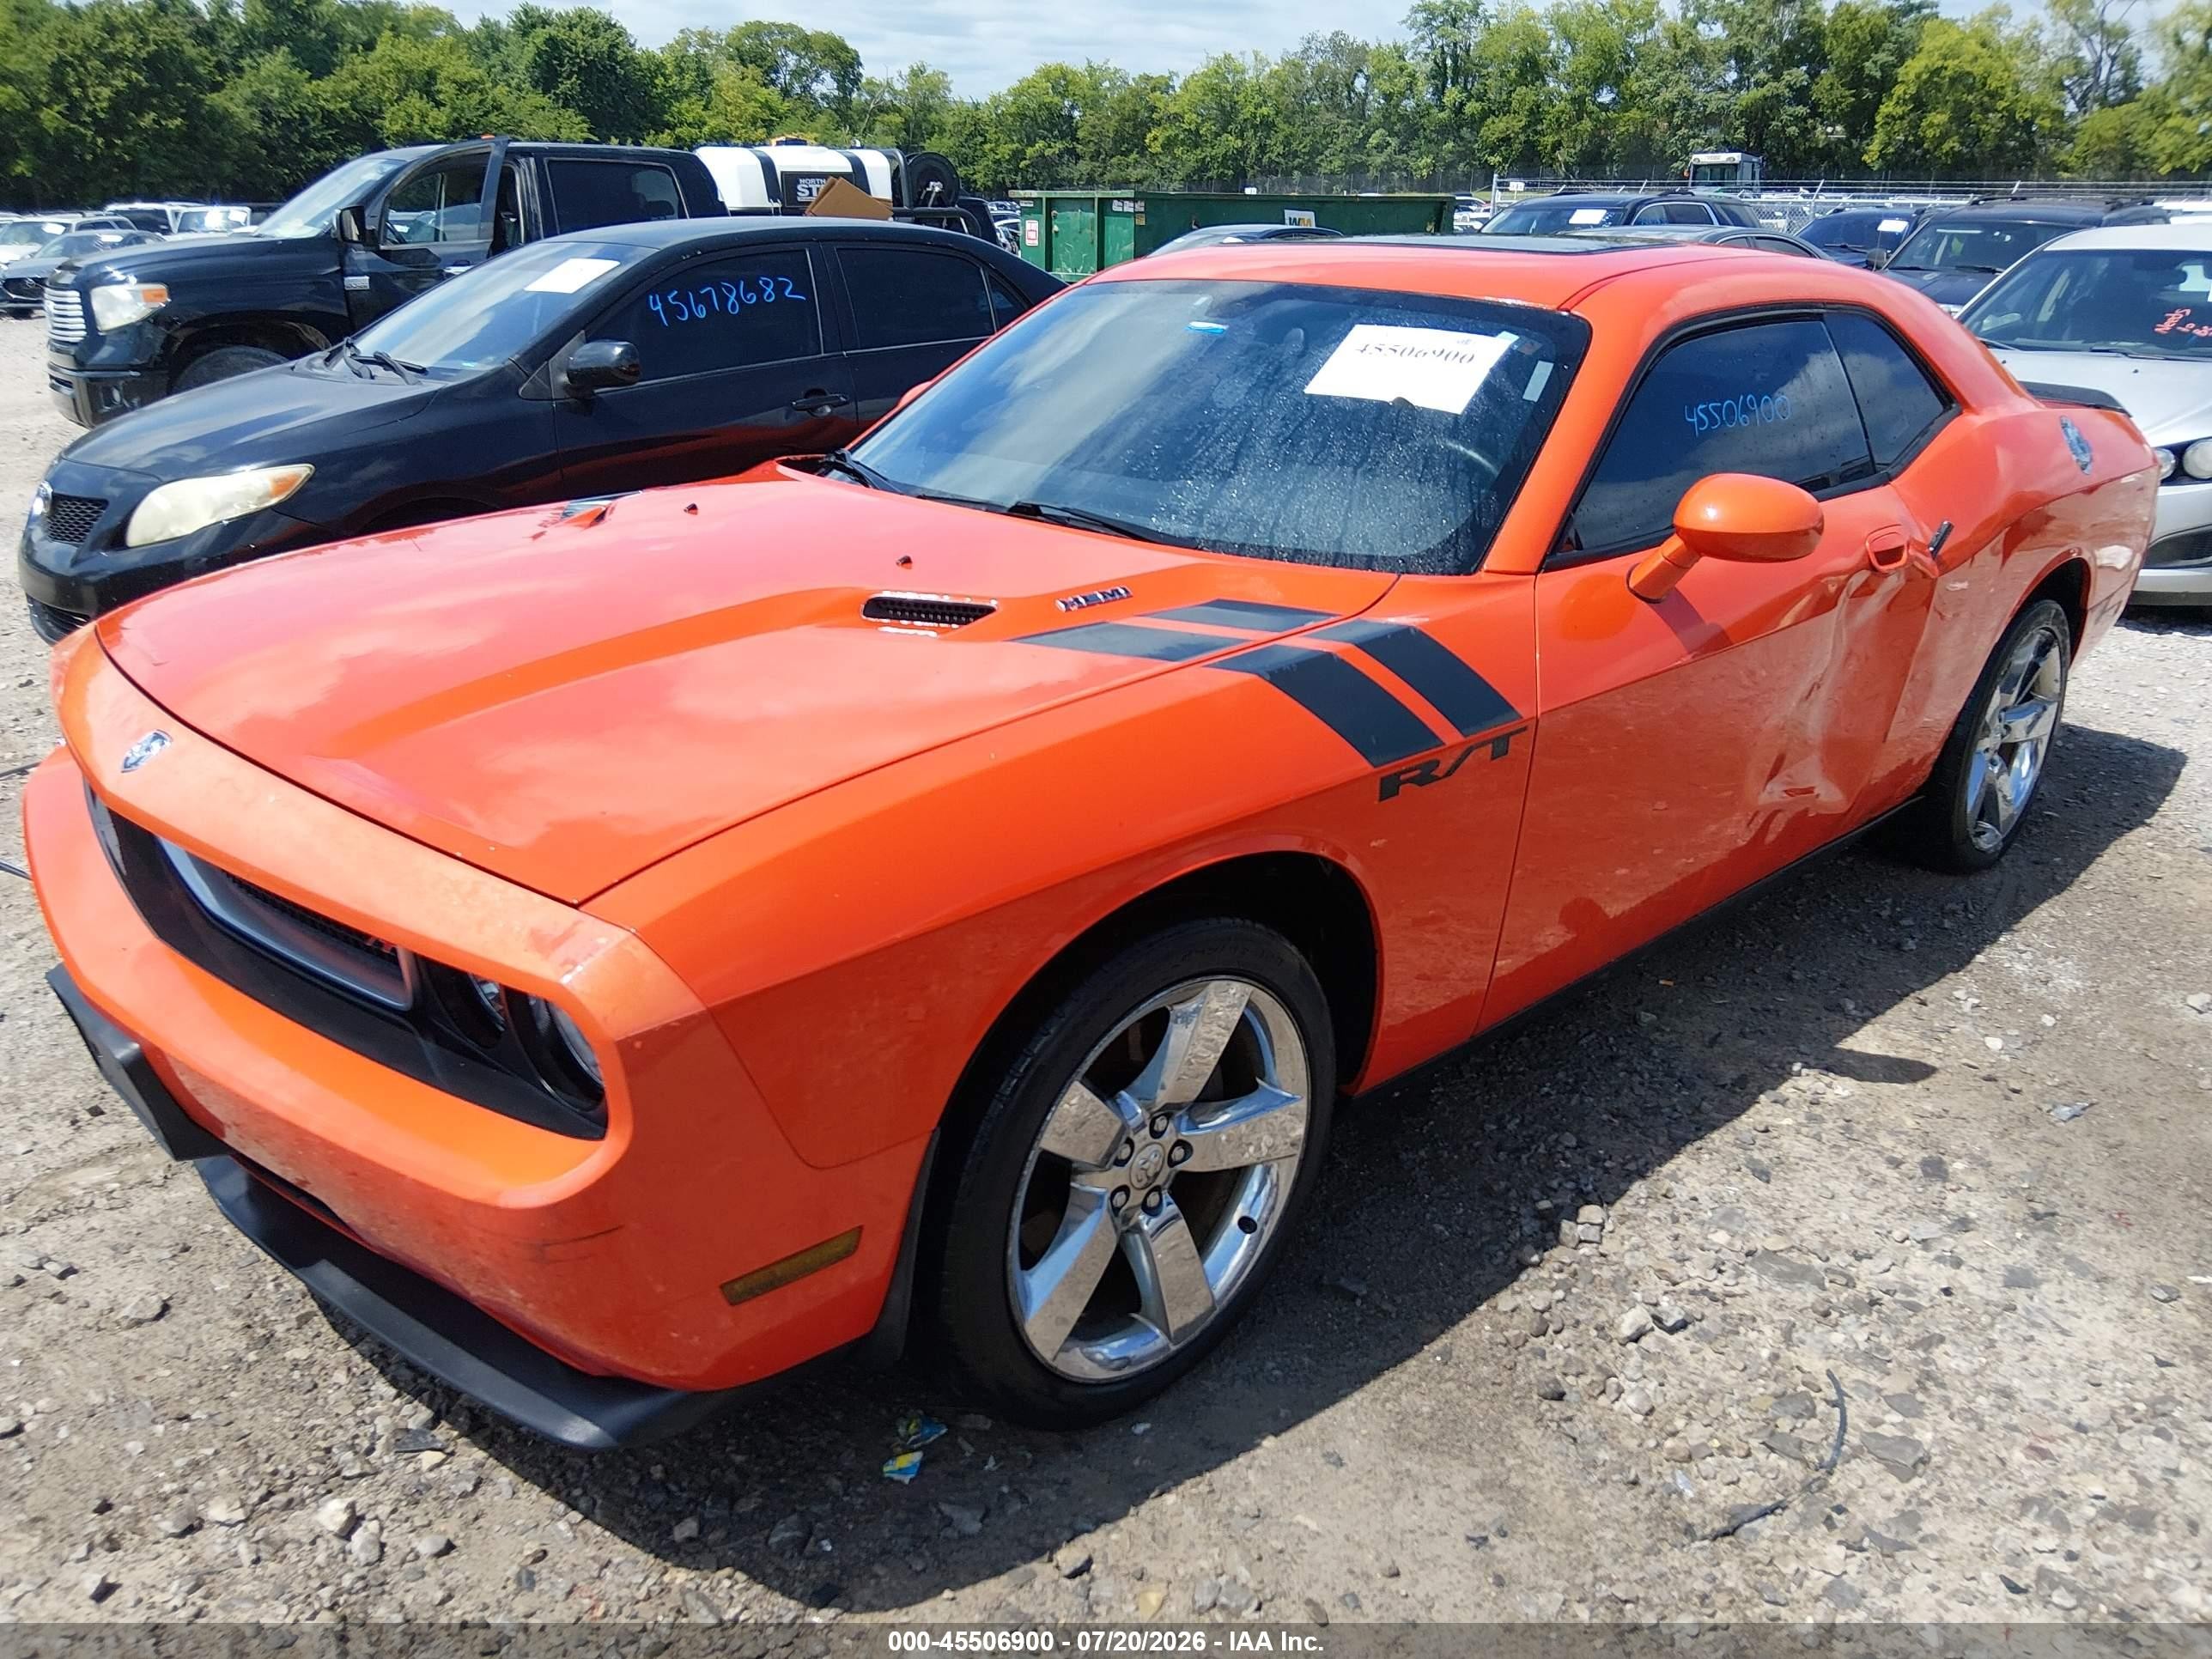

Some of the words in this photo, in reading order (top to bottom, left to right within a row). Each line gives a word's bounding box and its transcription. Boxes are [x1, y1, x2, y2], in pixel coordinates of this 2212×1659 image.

[649, 276, 806, 326] 45678682
[1355, 343, 1475, 364] 45506900
[1685, 394, 1791, 437] 45506900
[1055, 585, 1133, 612] HEMI
[1378, 726, 1528, 802] R/T
